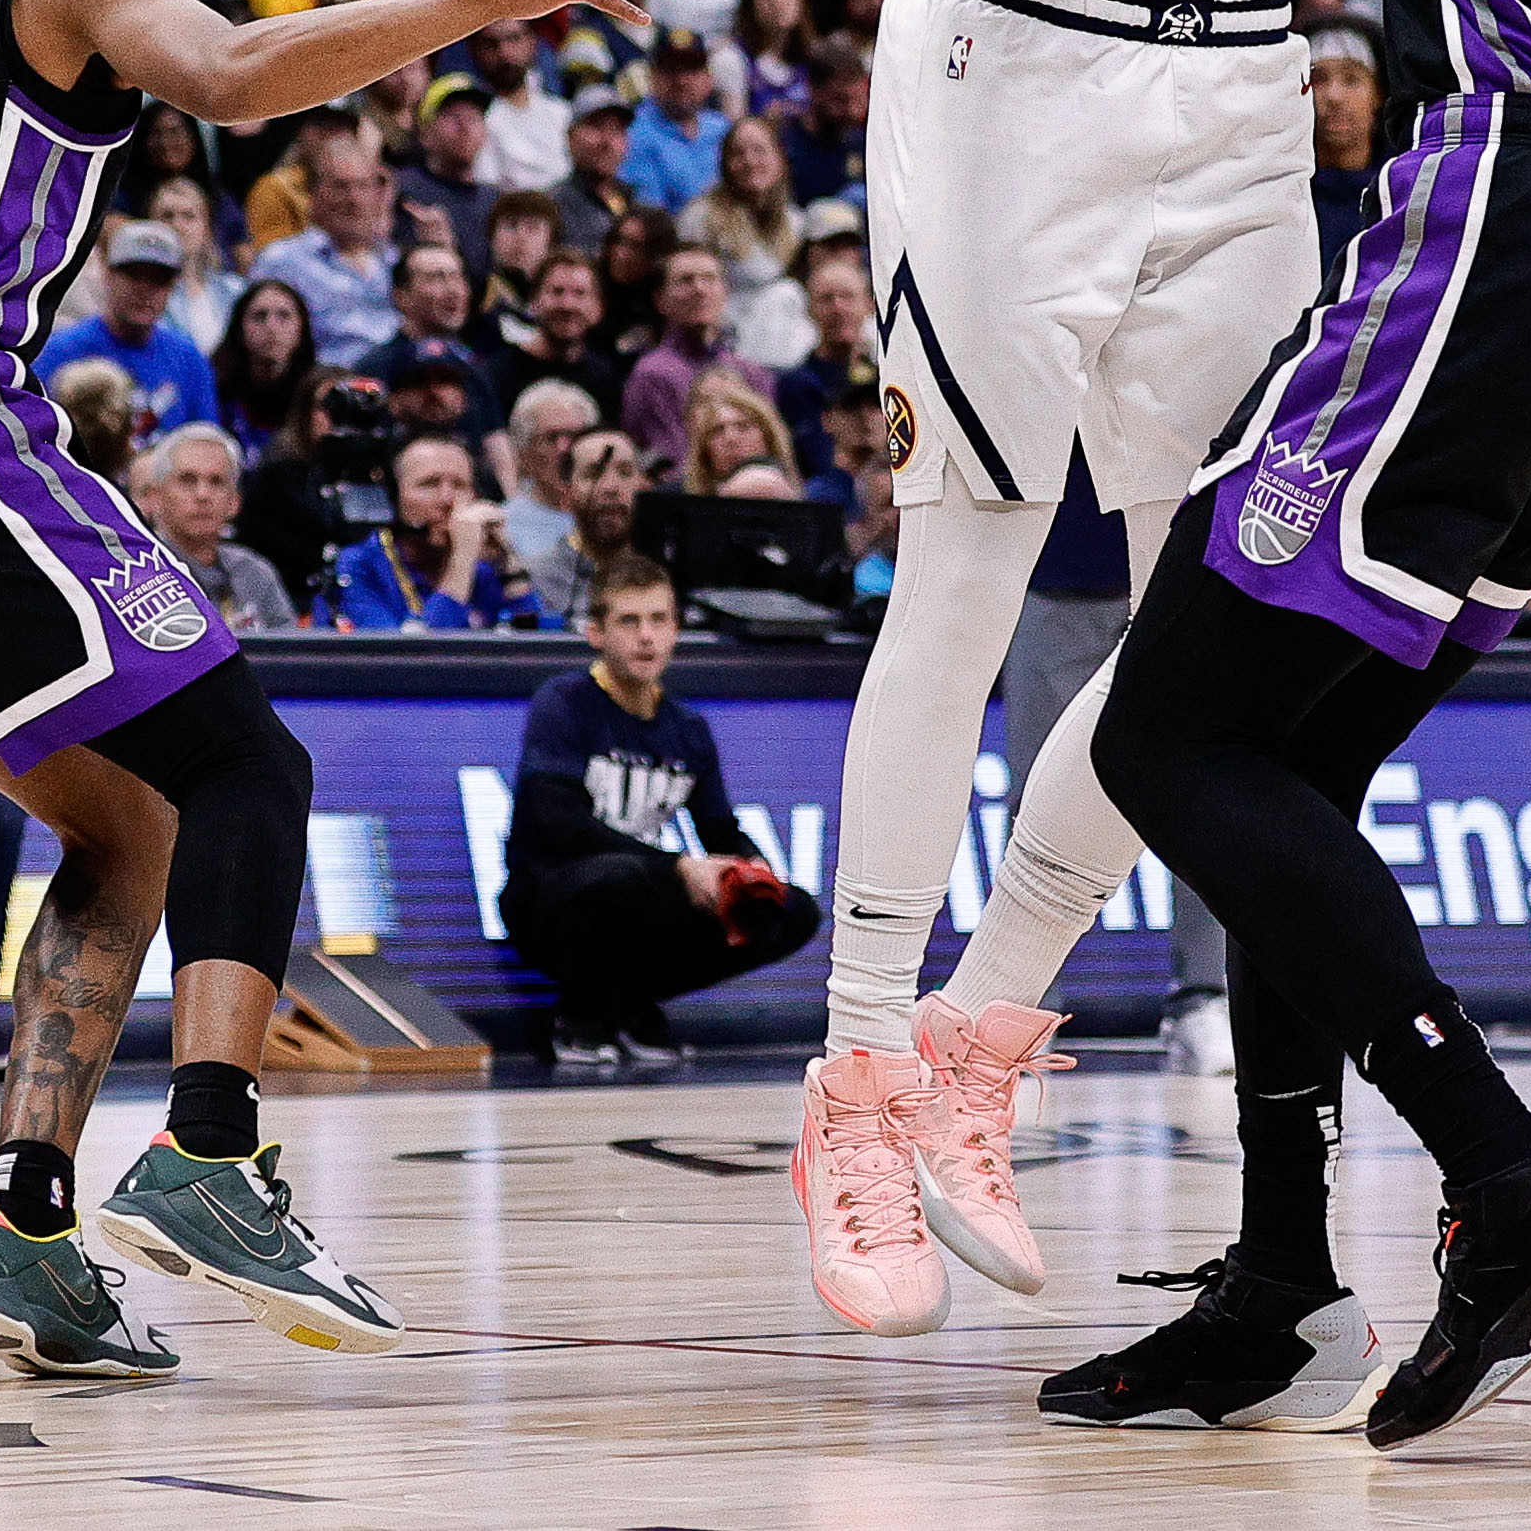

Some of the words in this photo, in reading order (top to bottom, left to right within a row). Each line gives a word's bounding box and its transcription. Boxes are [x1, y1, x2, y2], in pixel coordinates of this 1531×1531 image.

[1248, 482, 1321, 533] KINGS
[1257, 467, 1326, 508] SACRAMENTO
[116, 570, 176, 609] SACRAMENT
